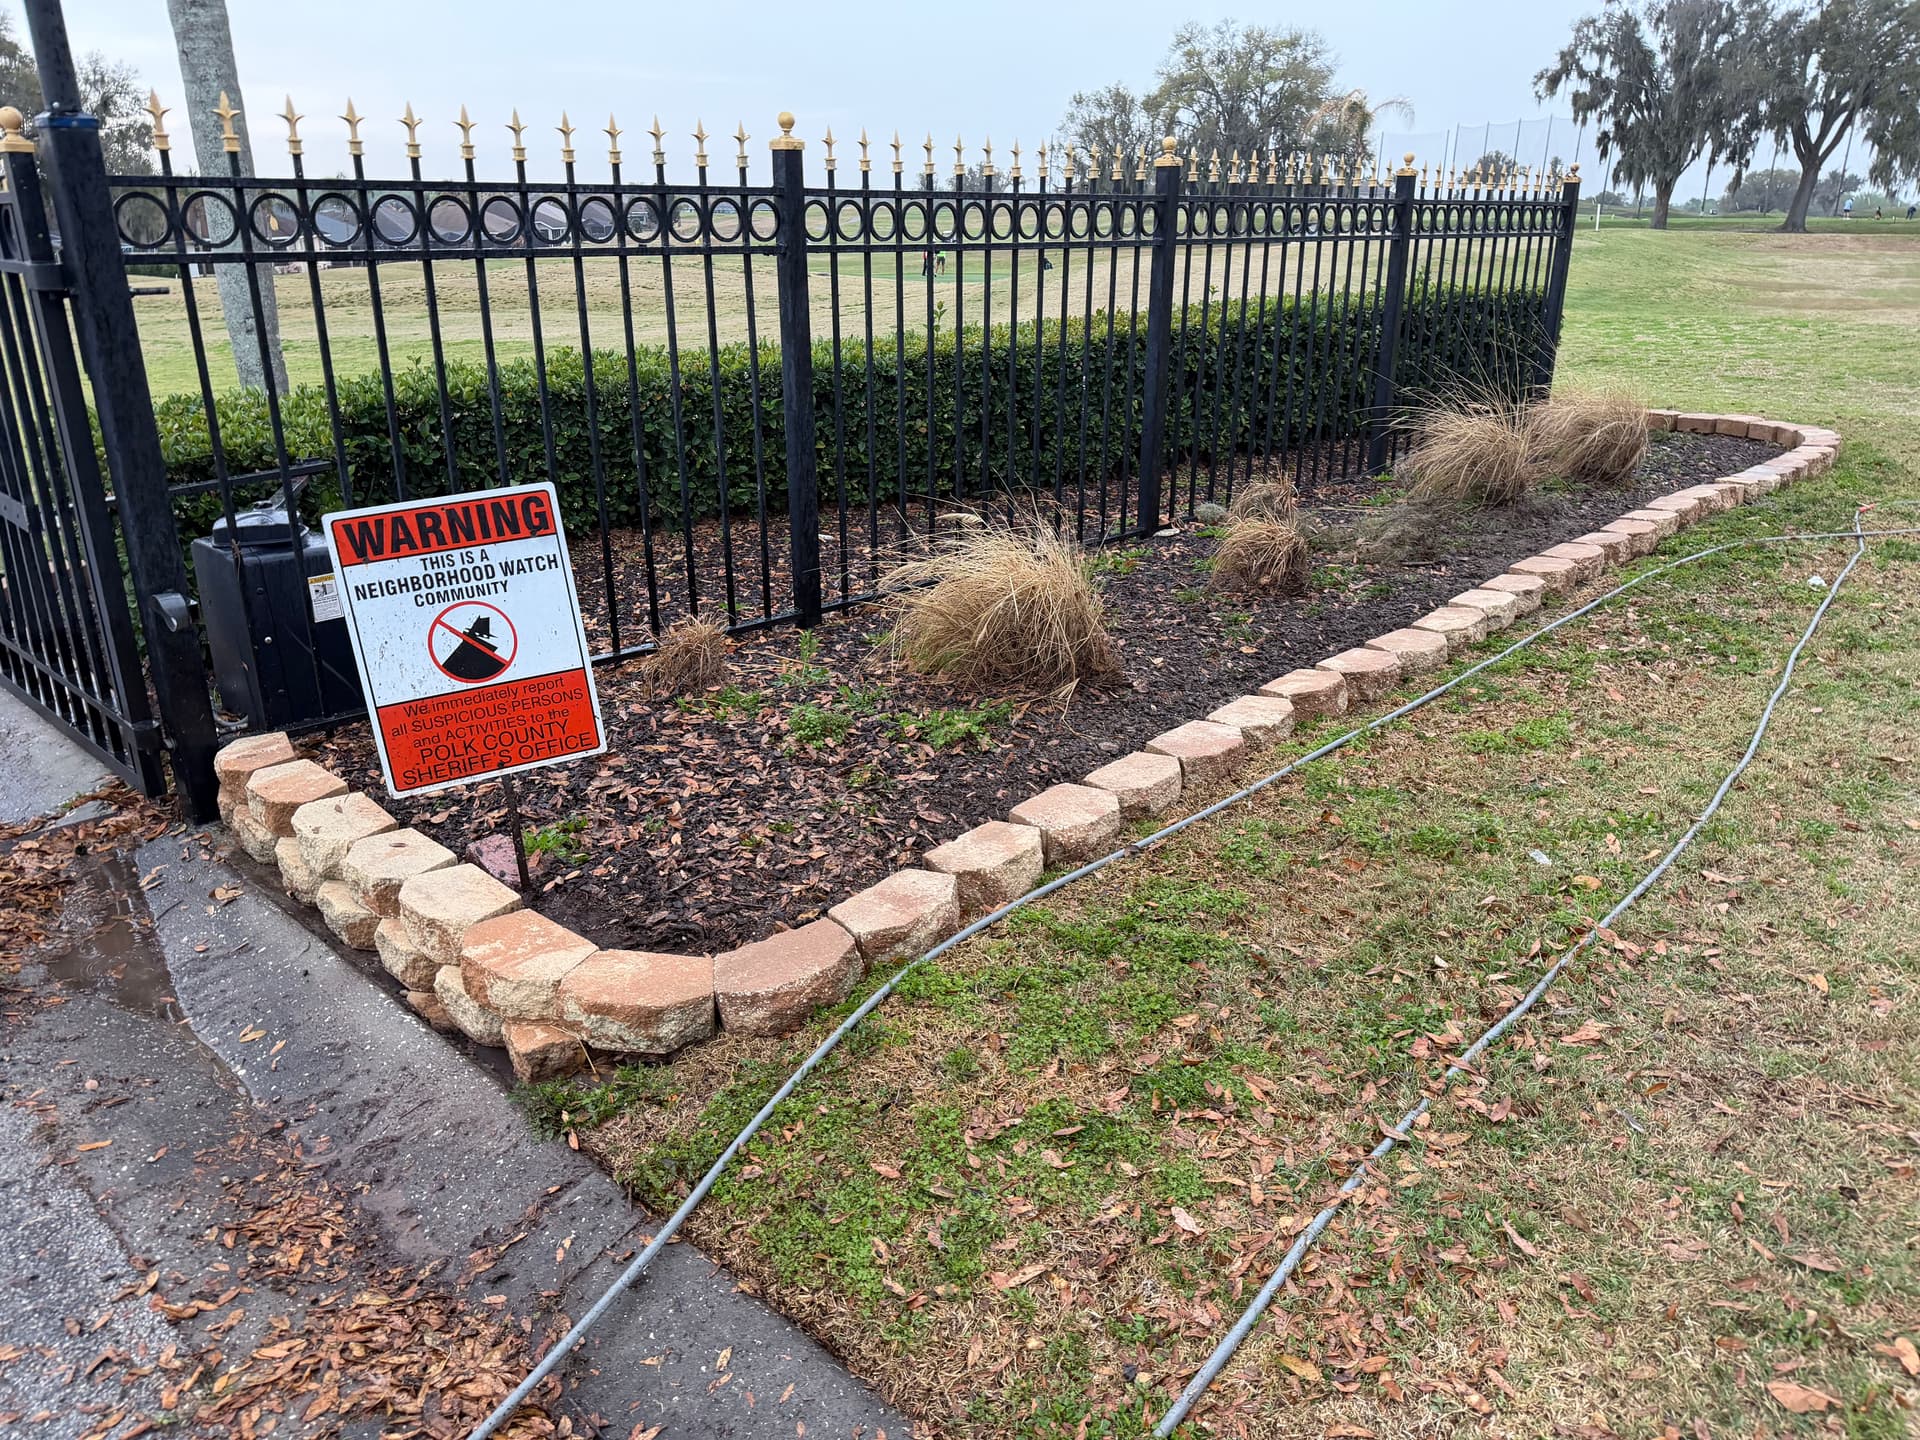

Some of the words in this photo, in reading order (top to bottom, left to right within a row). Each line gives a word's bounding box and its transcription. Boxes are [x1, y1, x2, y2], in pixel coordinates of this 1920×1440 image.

[342, 496, 549, 559] WARNING
[354, 564, 496, 601] NEIGHBORHOOD
[499, 553, 559, 577] WATCH
[420, 553, 455, 571] THIS
[460, 550, 475, 565] IS
[480, 548, 490, 562] A
[414, 580, 508, 607] COMMUNITY
[392, 723, 407, 737] all
[412, 703, 508, 733] SUSPICIOUS
[512, 688, 583, 712] PERSONS
[403, 703, 427, 718] We
[433, 685, 519, 713] immediately
[523, 677, 564, 696] report
[413, 735, 441, 748] and
[445, 714, 526, 741] ACTIVITIES
[530, 712, 544, 723] to
[549, 707, 570, 720] the
[420, 740, 478, 765] POLK
[483, 720, 568, 750] COUNTY
[402, 749, 512, 786] SHERIFF'S
[519, 732, 592, 760] OFFICE
